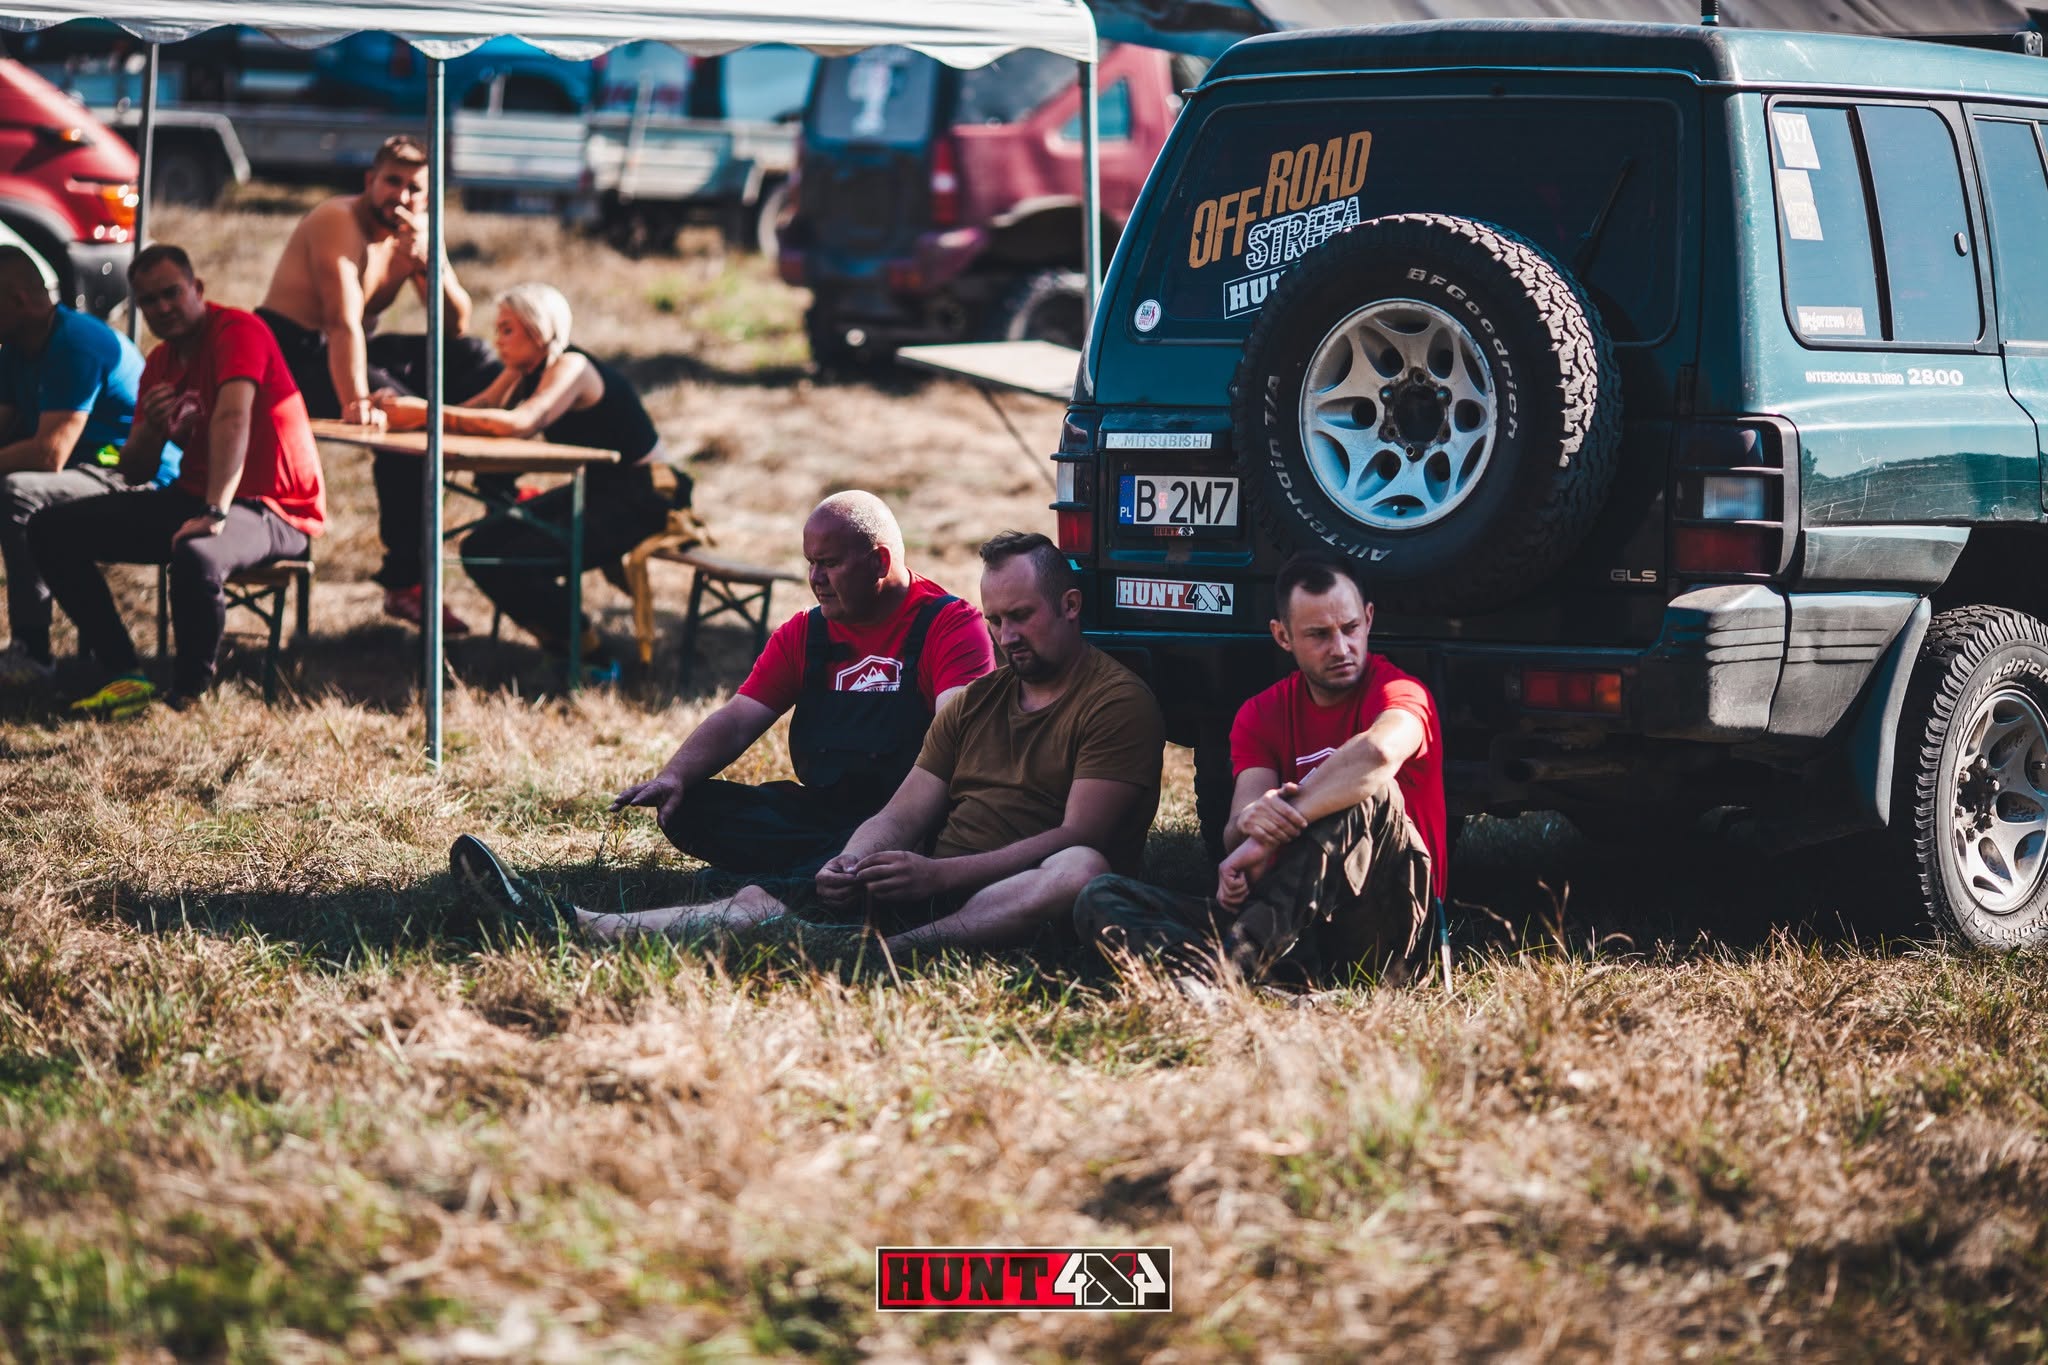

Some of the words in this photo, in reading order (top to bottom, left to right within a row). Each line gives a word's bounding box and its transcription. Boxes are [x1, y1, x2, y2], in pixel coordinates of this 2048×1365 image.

[1188, 186, 1262, 269] OFF
[1261, 130, 1373, 218] ROAD
[1406, 267, 1519, 440] BFGoodrich
[1805, 371, 1871, 384] INTERCOOLER
[1871, 372, 1905, 386] TURBO
[1906, 368, 1965, 386] 2800
[1124, 434, 1209, 448] MITSUBISHI
[1120, 506, 1132, 518] PL
[1610, 569, 1657, 583] GLS
